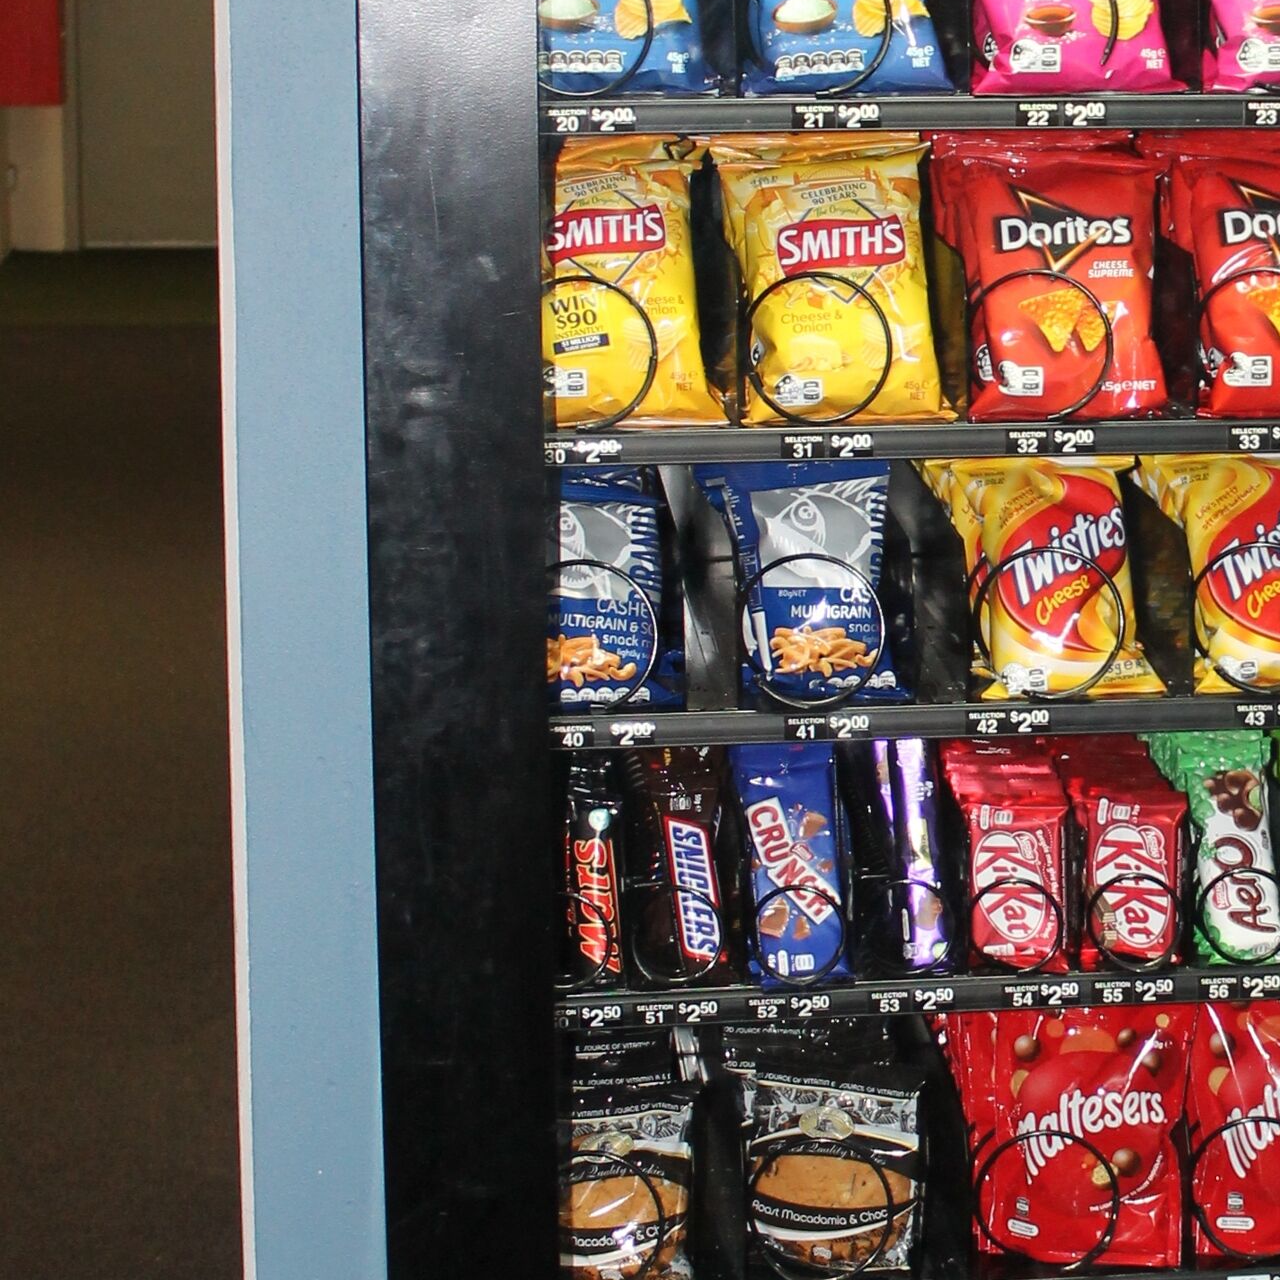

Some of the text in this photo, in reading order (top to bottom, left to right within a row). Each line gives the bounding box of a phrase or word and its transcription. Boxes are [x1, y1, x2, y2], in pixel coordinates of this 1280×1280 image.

[911, 55, 931, 68] NET
[1146, 59, 1163, 69] NET
[556, 117, 579, 132] 20
[803, 114, 824, 129] 21
[1027, 111, 1049, 126] 22
[1255, 110, 1277, 125] 23
[563, 175, 629, 194] CELEBRATING
[574, 183, 619, 198] 90 YEARS
[800, 181, 867, 200] CELEBRATING
[811, 191, 858, 206] 90 YEARS
[546, 209, 664, 251] SMITH'S
[1000, 215, 1133, 252] Doritos
[778, 219, 905, 266] SMITH'S
[1092, 260, 1129, 270] CHEESE
[1088, 269, 1134, 279] SUPREME
[549, 293, 598, 317] WIN
[556, 308, 598, 331] $90
[780, 311, 843, 324] Cheese &
[792, 321, 833, 334] Onion
[676, 382, 694, 393] NET
[1131, 380, 1157, 391] NET
[909, 390, 927, 401] NET
[1017, 438, 1039, 453] 32
[1239, 435, 1261, 450] 33
[792, 443, 813, 458] 31
[1002, 506, 1127, 606] Twisties
[1035, 575, 1090, 625] Cheese
[629, 621, 640, 633] &
[602, 633, 640, 648] snack
[615, 648, 641, 661] lightly
[1244, 711, 1266, 726] 43
[795, 724, 816, 739] 41
[976, 720, 998, 734] 42
[562, 732, 584, 746] 40
[751, 805, 838, 917] CRUNCH
[672, 824, 719, 958] SNICKERS
[1214, 834, 1278, 934] Aero
[574, 838, 622, 974] Mars
[1102, 989, 1123, 1003] 55
[1208, 985, 1230, 999] 56
[879, 999, 900, 1013] 53
[1012, 993, 1034, 1007] 54
[645, 1011, 664, 1026] 51
[756, 1005, 778, 1020] 52
[765, 1073, 831, 1086] SOURCE VITAMIN
[839, 1082, 865, 1092] SOURCE
[1017, 1088, 1164, 1185] Maltesers
[808, 1142, 849, 1159] Quality
[752, 1198, 888, 1227] Roast Macadamia & Choc
